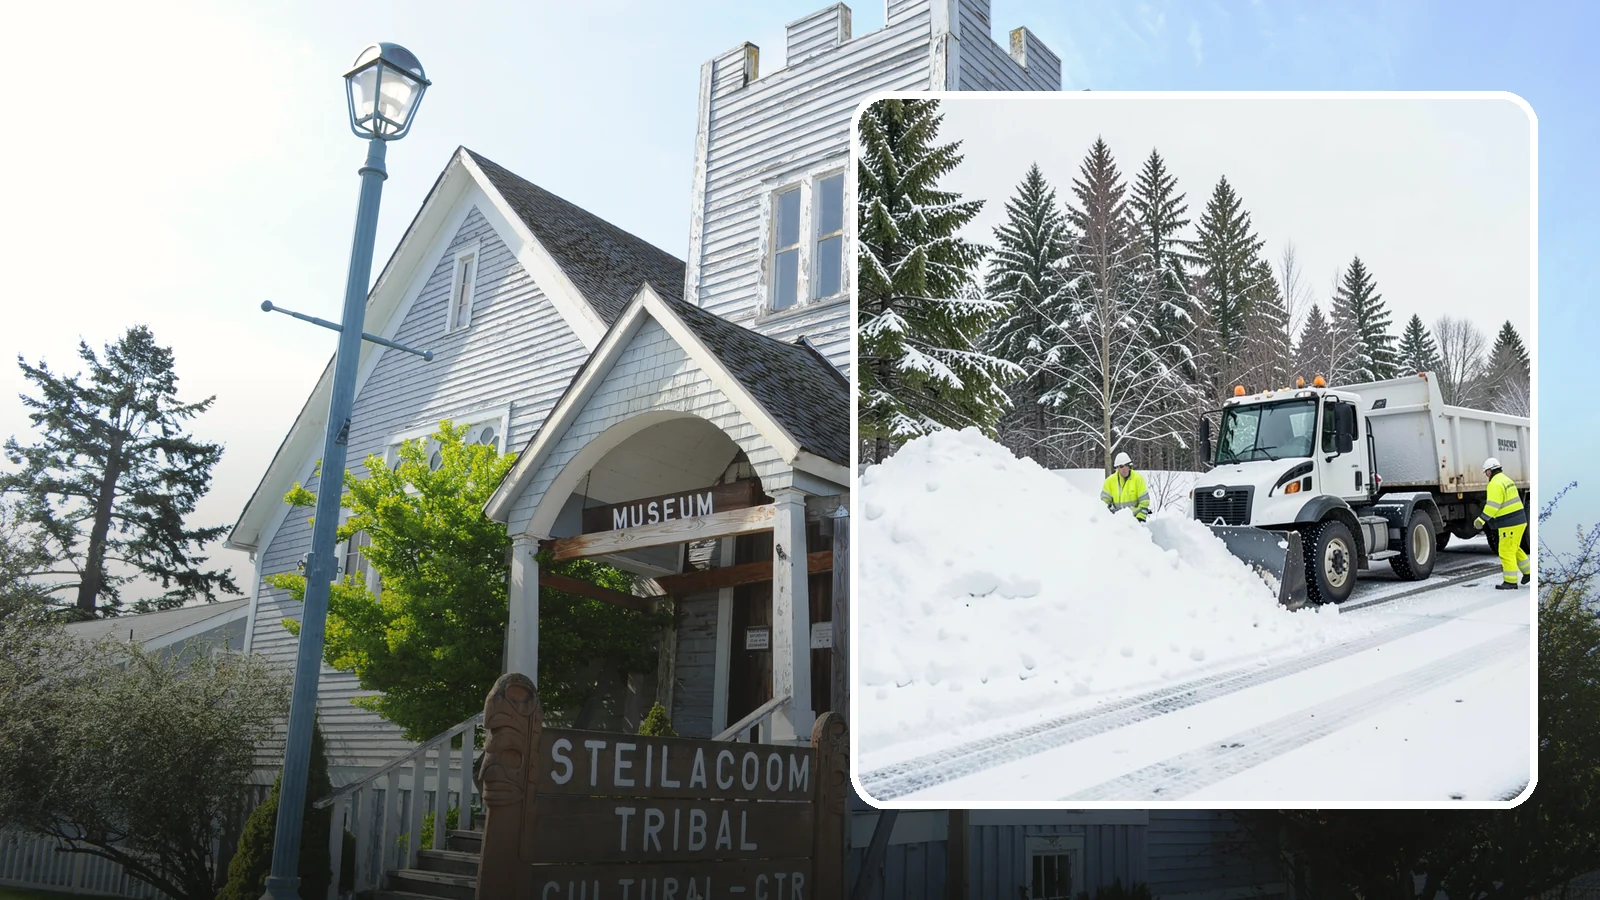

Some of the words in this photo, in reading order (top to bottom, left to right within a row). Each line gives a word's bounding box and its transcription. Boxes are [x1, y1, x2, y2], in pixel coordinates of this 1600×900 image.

[612, 491, 714, 531] MUSEUM
[551, 738, 809, 792] STEILACOOM
[615, 807, 757, 852] TRIBAL
